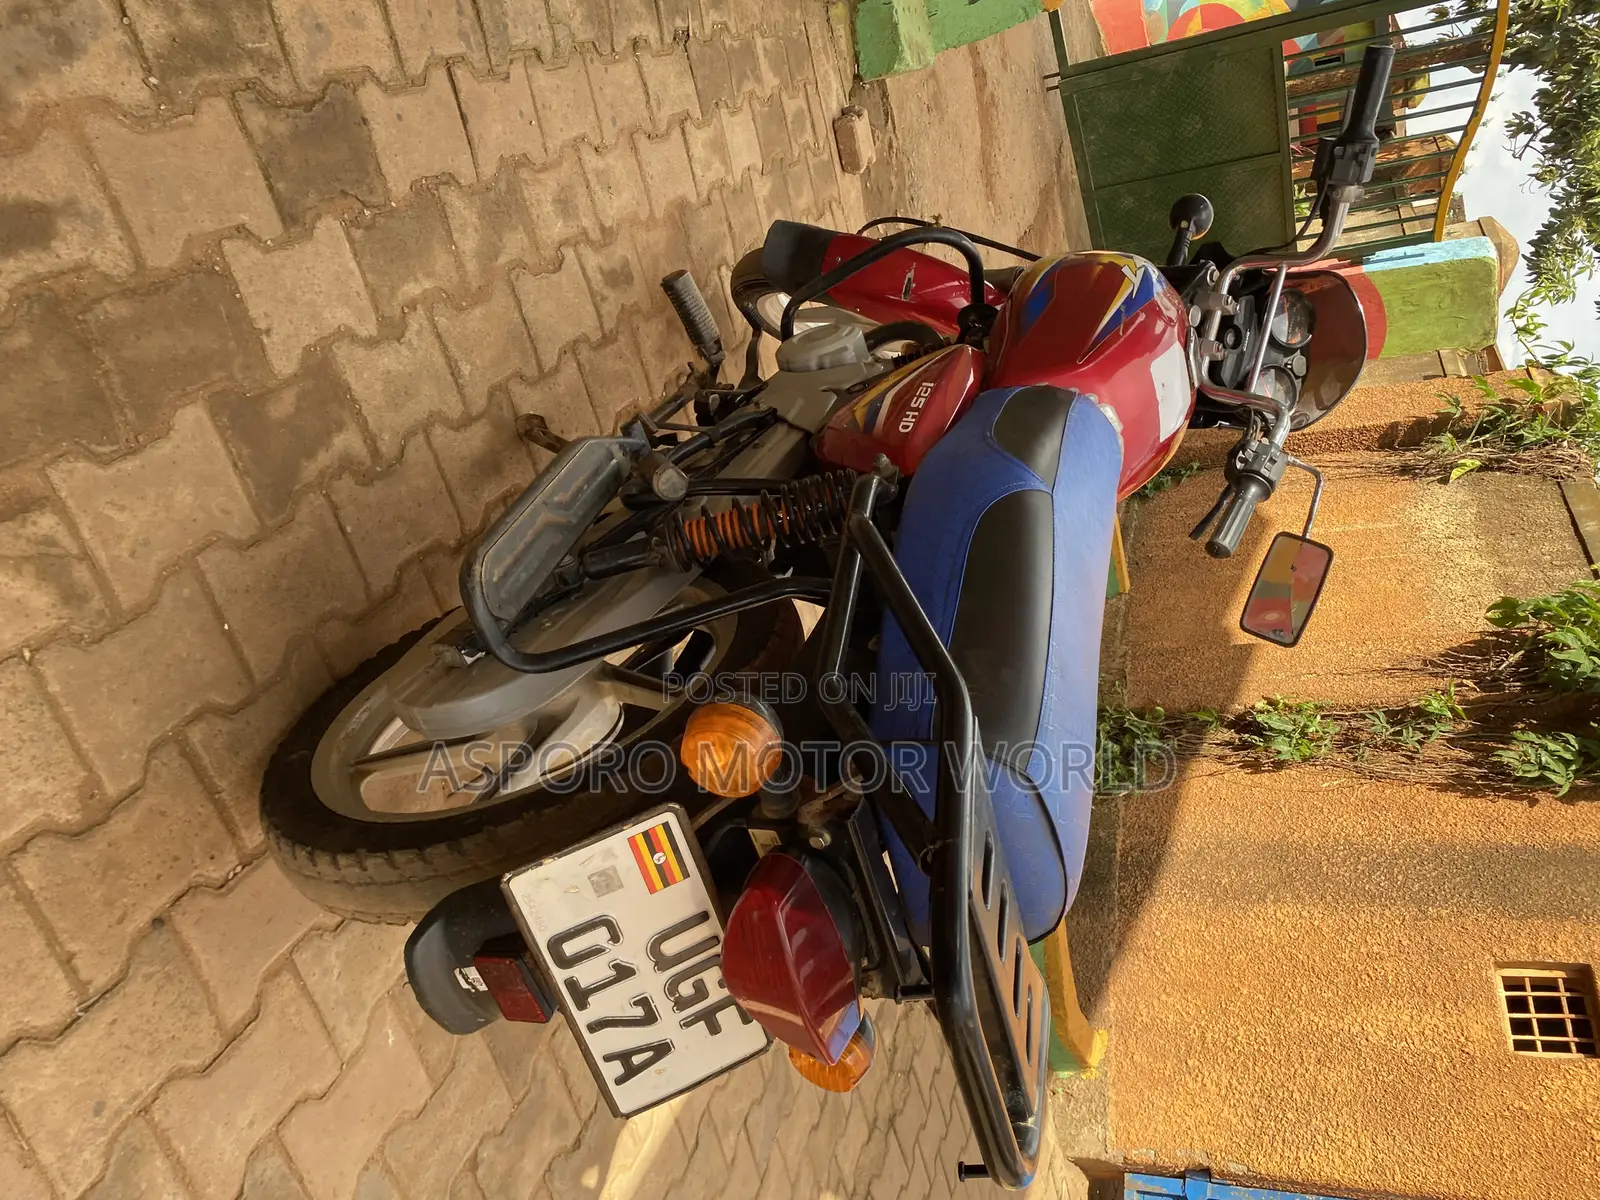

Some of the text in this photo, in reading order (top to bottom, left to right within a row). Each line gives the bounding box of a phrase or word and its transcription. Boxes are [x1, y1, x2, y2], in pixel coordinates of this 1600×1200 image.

[899, 382, 935, 433] 125 HD
[547, 914, 675, 1086] 017A
[645, 910, 754, 1037] UGF
